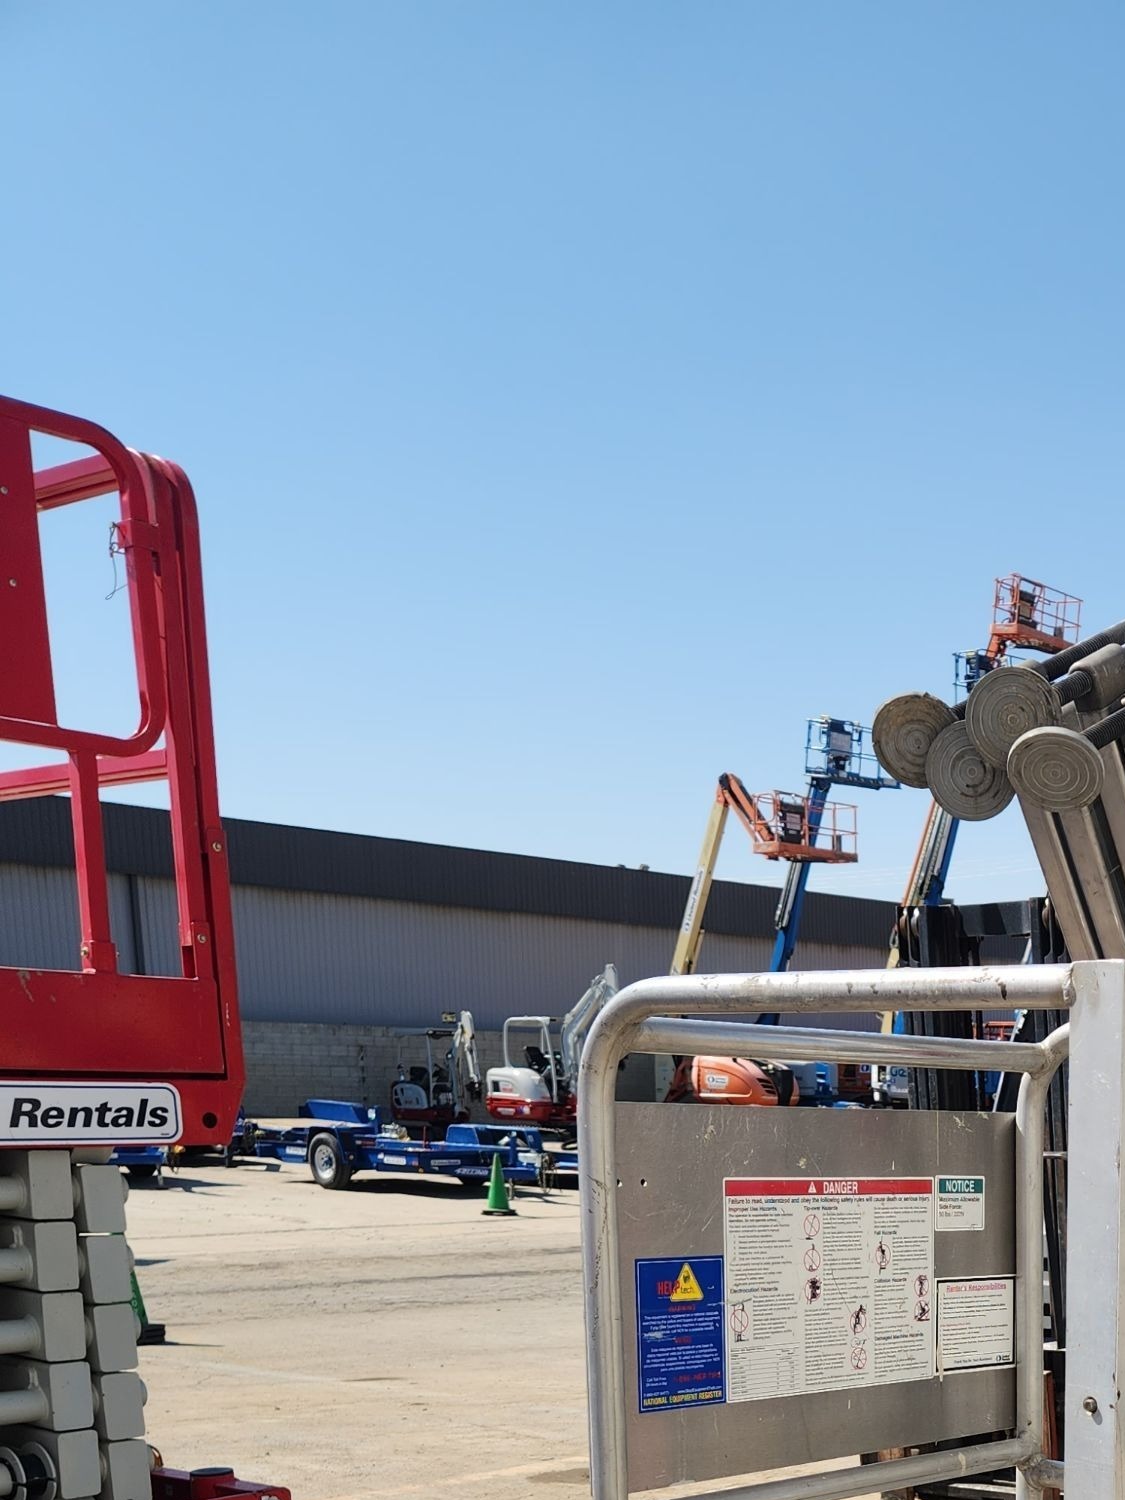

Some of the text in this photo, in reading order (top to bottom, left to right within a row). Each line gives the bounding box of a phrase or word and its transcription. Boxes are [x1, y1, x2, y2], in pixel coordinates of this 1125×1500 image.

[9, 1097, 169, 1128] Rentals
[823, 1181, 858, 1194] DANGER
[945, 1180, 975, 1193] NOTICE
[820, 1196, 840, 1204] following
[698, 1390, 722, 1400] REGISTER
